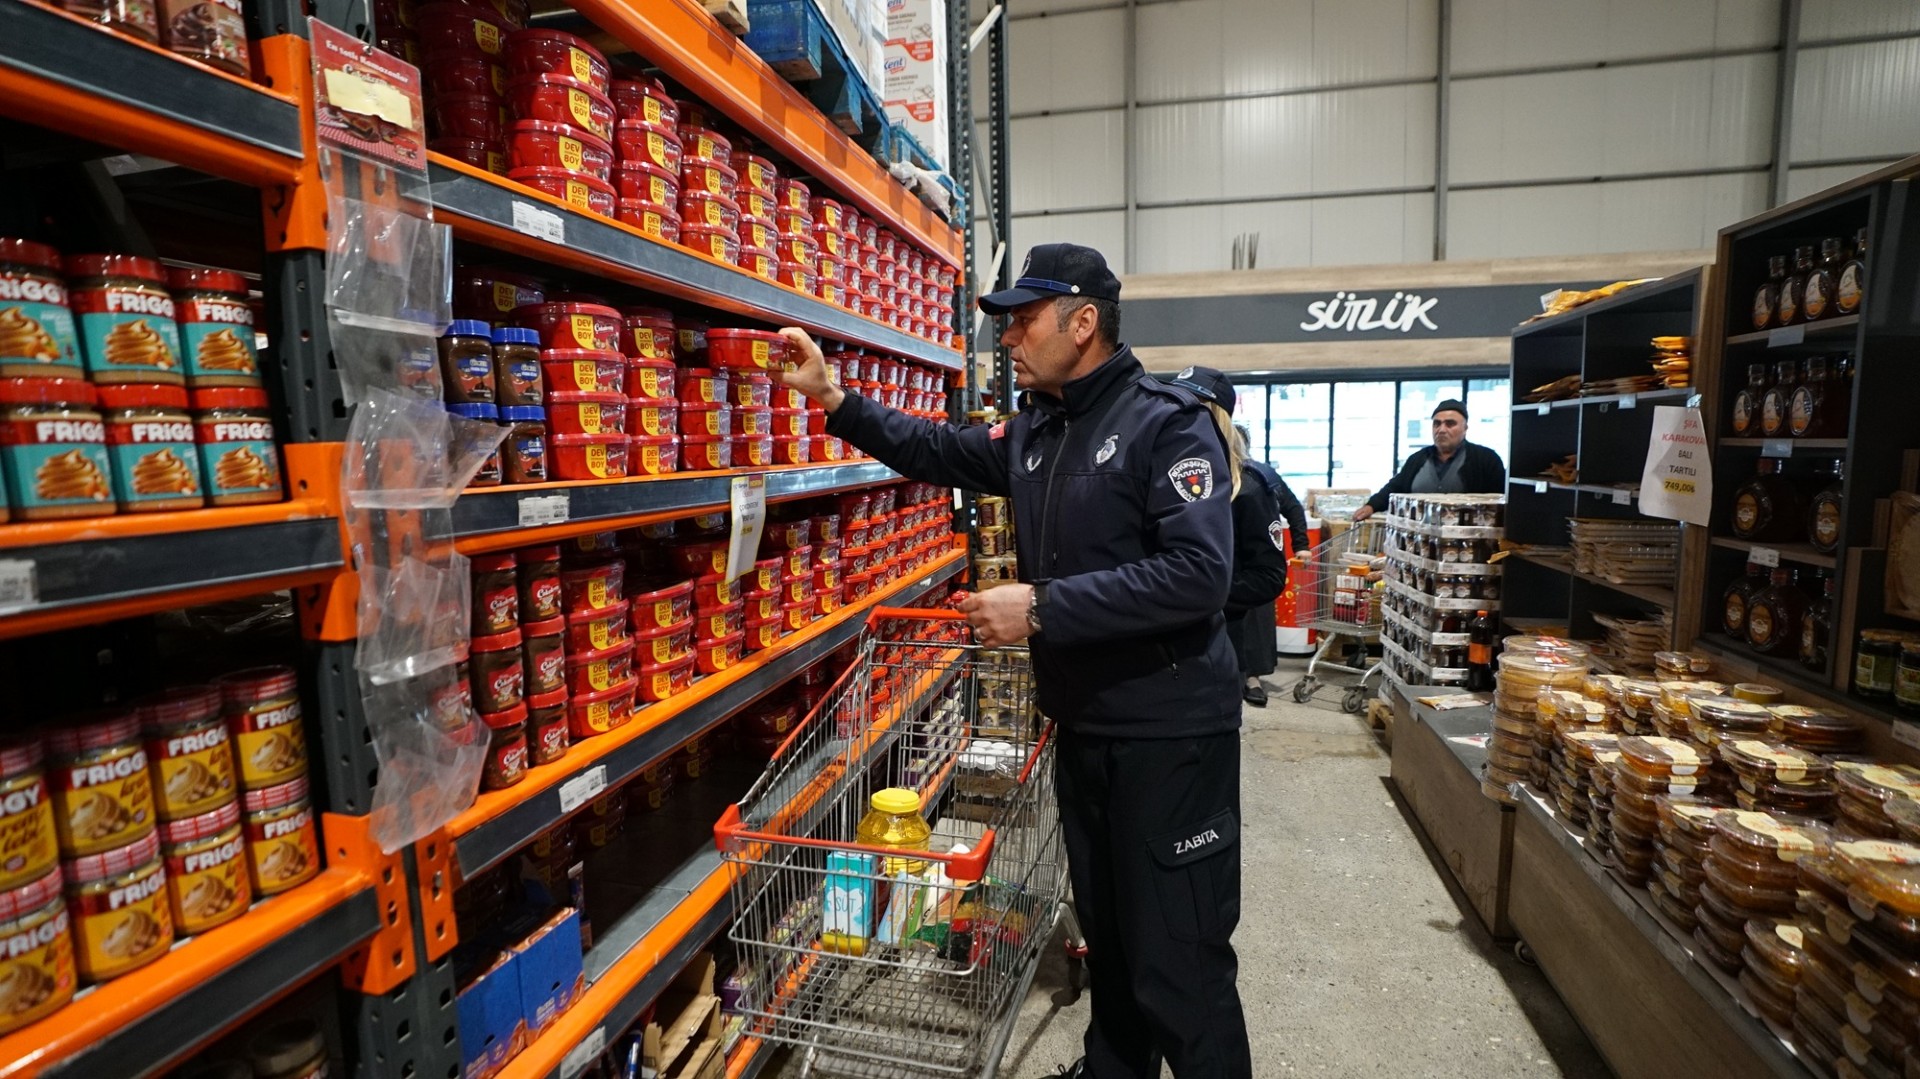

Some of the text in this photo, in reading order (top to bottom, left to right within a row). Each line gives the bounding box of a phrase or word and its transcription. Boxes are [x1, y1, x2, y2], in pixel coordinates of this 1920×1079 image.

[481, 25, 497, 37] DEV
[326, 40, 338, 52] En
[481, 38, 497, 49] BOY
[576, 52, 589, 64] DEV
[576, 65, 589, 76] BOY
[574, 92, 588, 105] DEV
[648, 102, 659, 110] DEV
[574, 106, 588, 118] BOY
[648, 112, 659, 122] BOY
[564, 141, 580, 153] DEV
[564, 154, 580, 165] BOY
[572, 186, 586, 196] DEV
[572, 199, 586, 208] BOY
[648, 216, 659, 224] DEV
[648, 227, 659, 236] BOY
[1300, 291, 1438, 332] SÜTLÜK
[577, 318, 592, 327] DEV
[577, 332, 592, 340] BOY
[640, 332, 652, 340] DEV
[640, 342, 652, 350] BOY
[579, 364, 594, 373] DEV
[644, 372, 656, 380] DEV
[579, 376, 594, 385] BOY
[644, 382, 656, 390] BOY
[584, 407, 598, 415] DEV
[646, 410, 658, 418] DEV
[584, 418, 598, 427] BOY
[591, 448, 604, 456] DEV
[1678, 450, 1693, 459] BALI
[591, 460, 604, 468] BOY
[1669, 464, 1697, 476] TARTILI
[592, 582, 604, 590] DEV
[592, 594, 604, 602] BOY
[659, 603, 670, 611] DEV
[659, 612, 670, 620] BOY
[594, 622, 606, 630] DEV
[594, 634, 606, 642] BOY
[656, 640, 668, 648] DEV
[656, 650, 668, 658] BOY
[593, 664, 606, 672] DEV
[593, 676, 606, 684] BOY
[656, 676, 668, 684] DEV
[656, 686, 668, 694] BOY
[592, 706, 606, 714] DEV
[592, 716, 606, 725] BOY
[0, 784, 40, 816] GY
[1174, 829, 1219, 854] ZABITA
